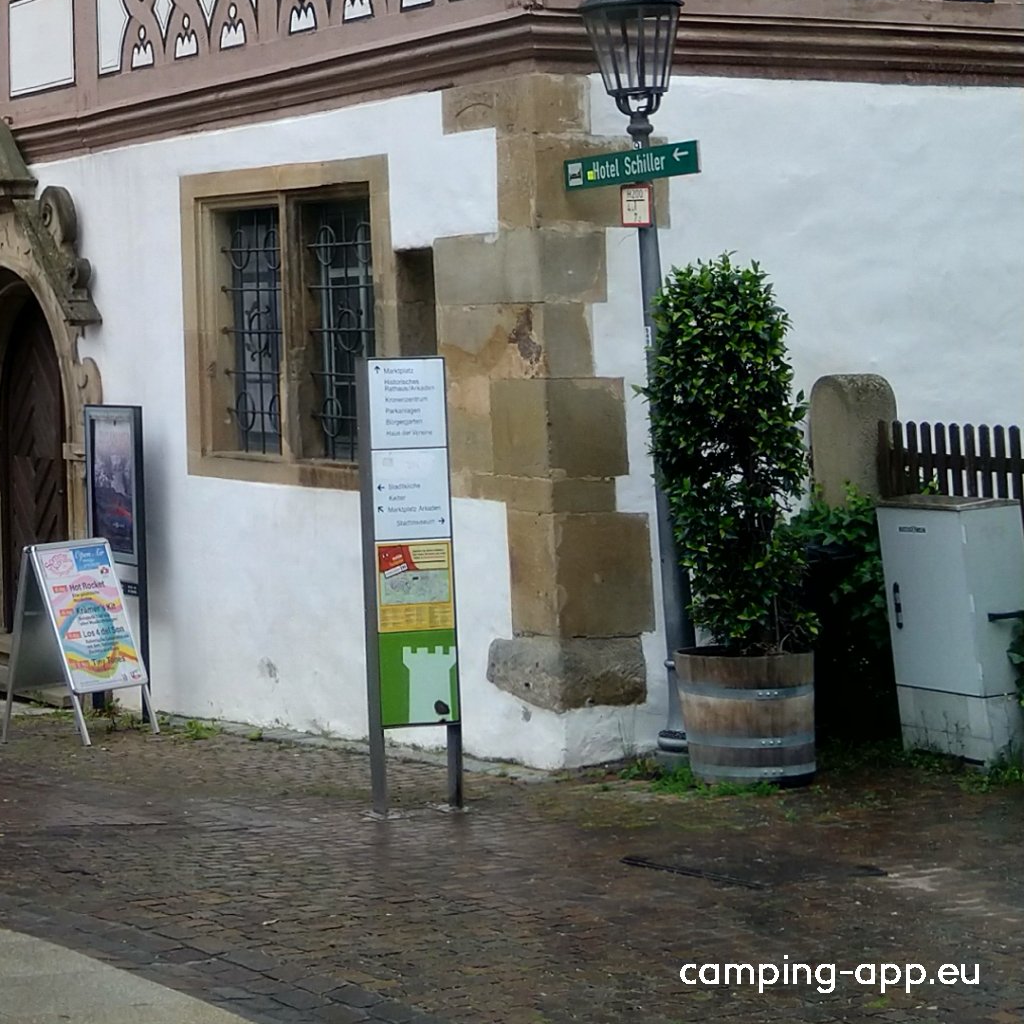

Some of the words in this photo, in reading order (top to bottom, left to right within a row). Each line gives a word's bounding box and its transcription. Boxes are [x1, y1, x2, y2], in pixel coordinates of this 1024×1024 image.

[592, 160, 620, 180] Hotel
[624, 153, 666, 176] Schiller
[383, 367, 414, 375] Marktplatz
[69, 583, 81, 592] Hot
[82, 580, 105, 590] Rocket
[82, 630, 95, 638] Los
